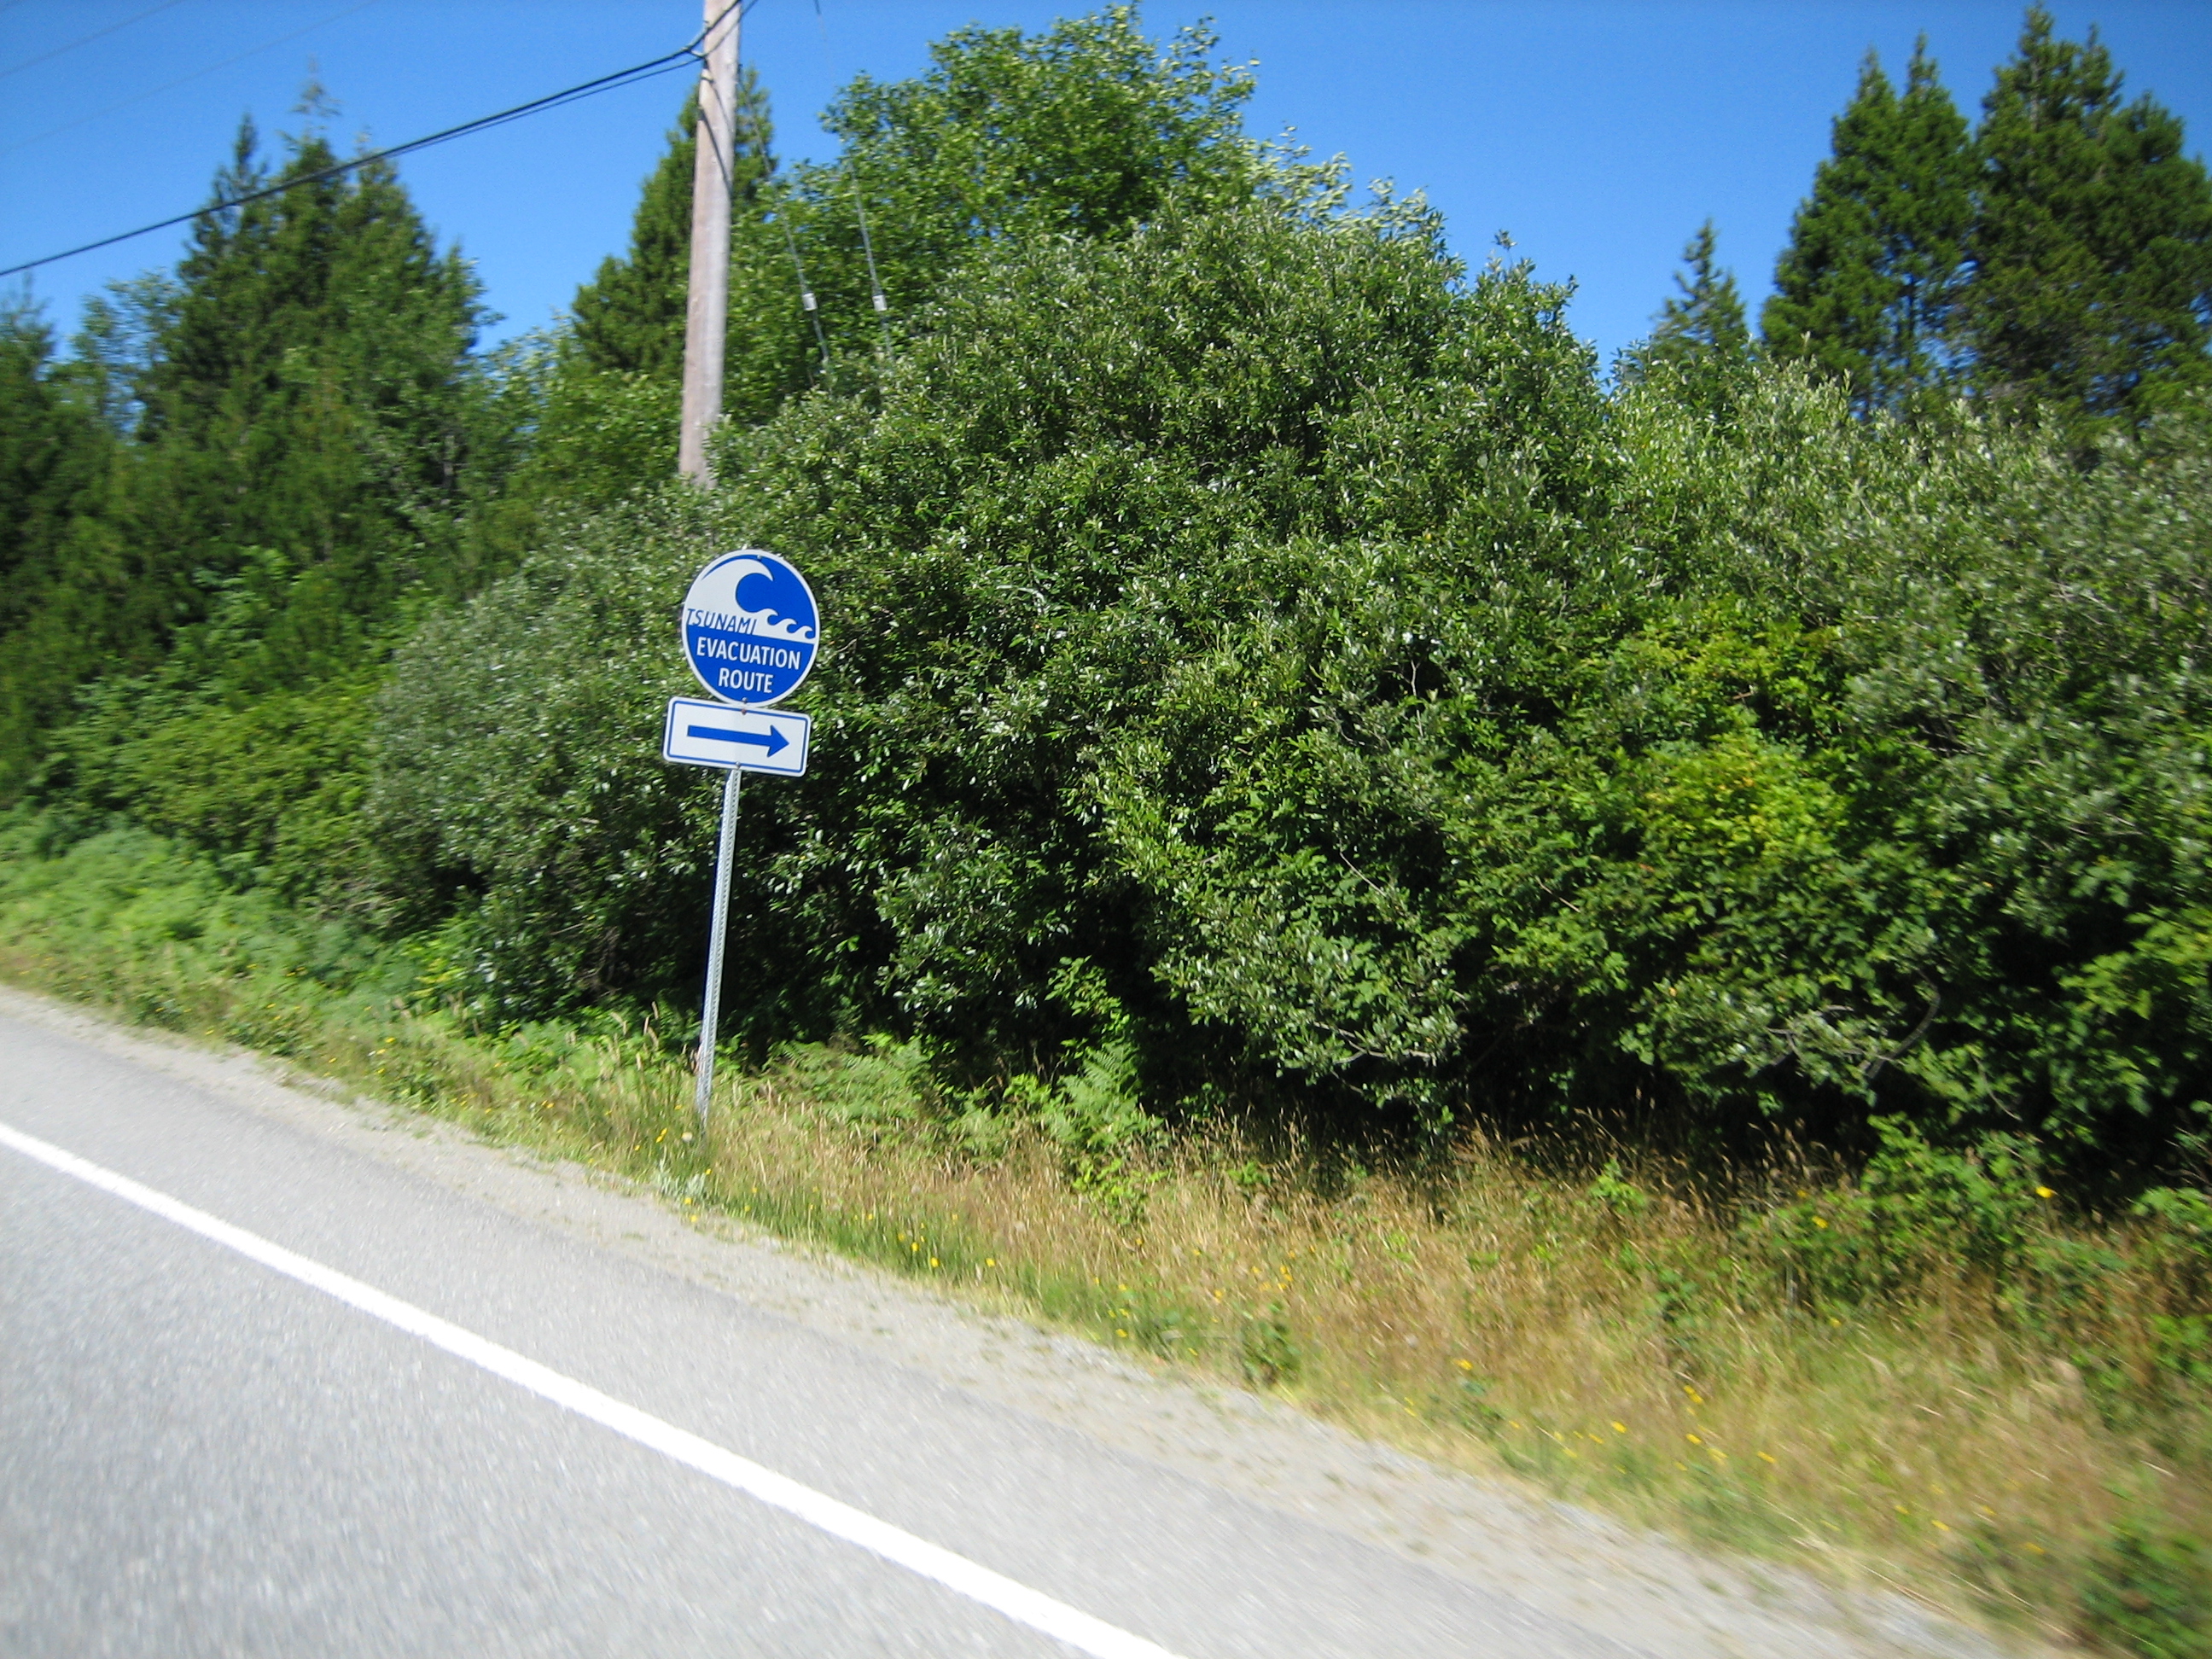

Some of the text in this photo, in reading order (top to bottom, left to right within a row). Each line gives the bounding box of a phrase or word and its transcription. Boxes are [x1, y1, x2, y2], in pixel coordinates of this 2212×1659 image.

[687, 608, 757, 635] TSUNAMI
[696, 637, 801, 670] EVACUATION
[718, 667, 774, 693] ROUTE
